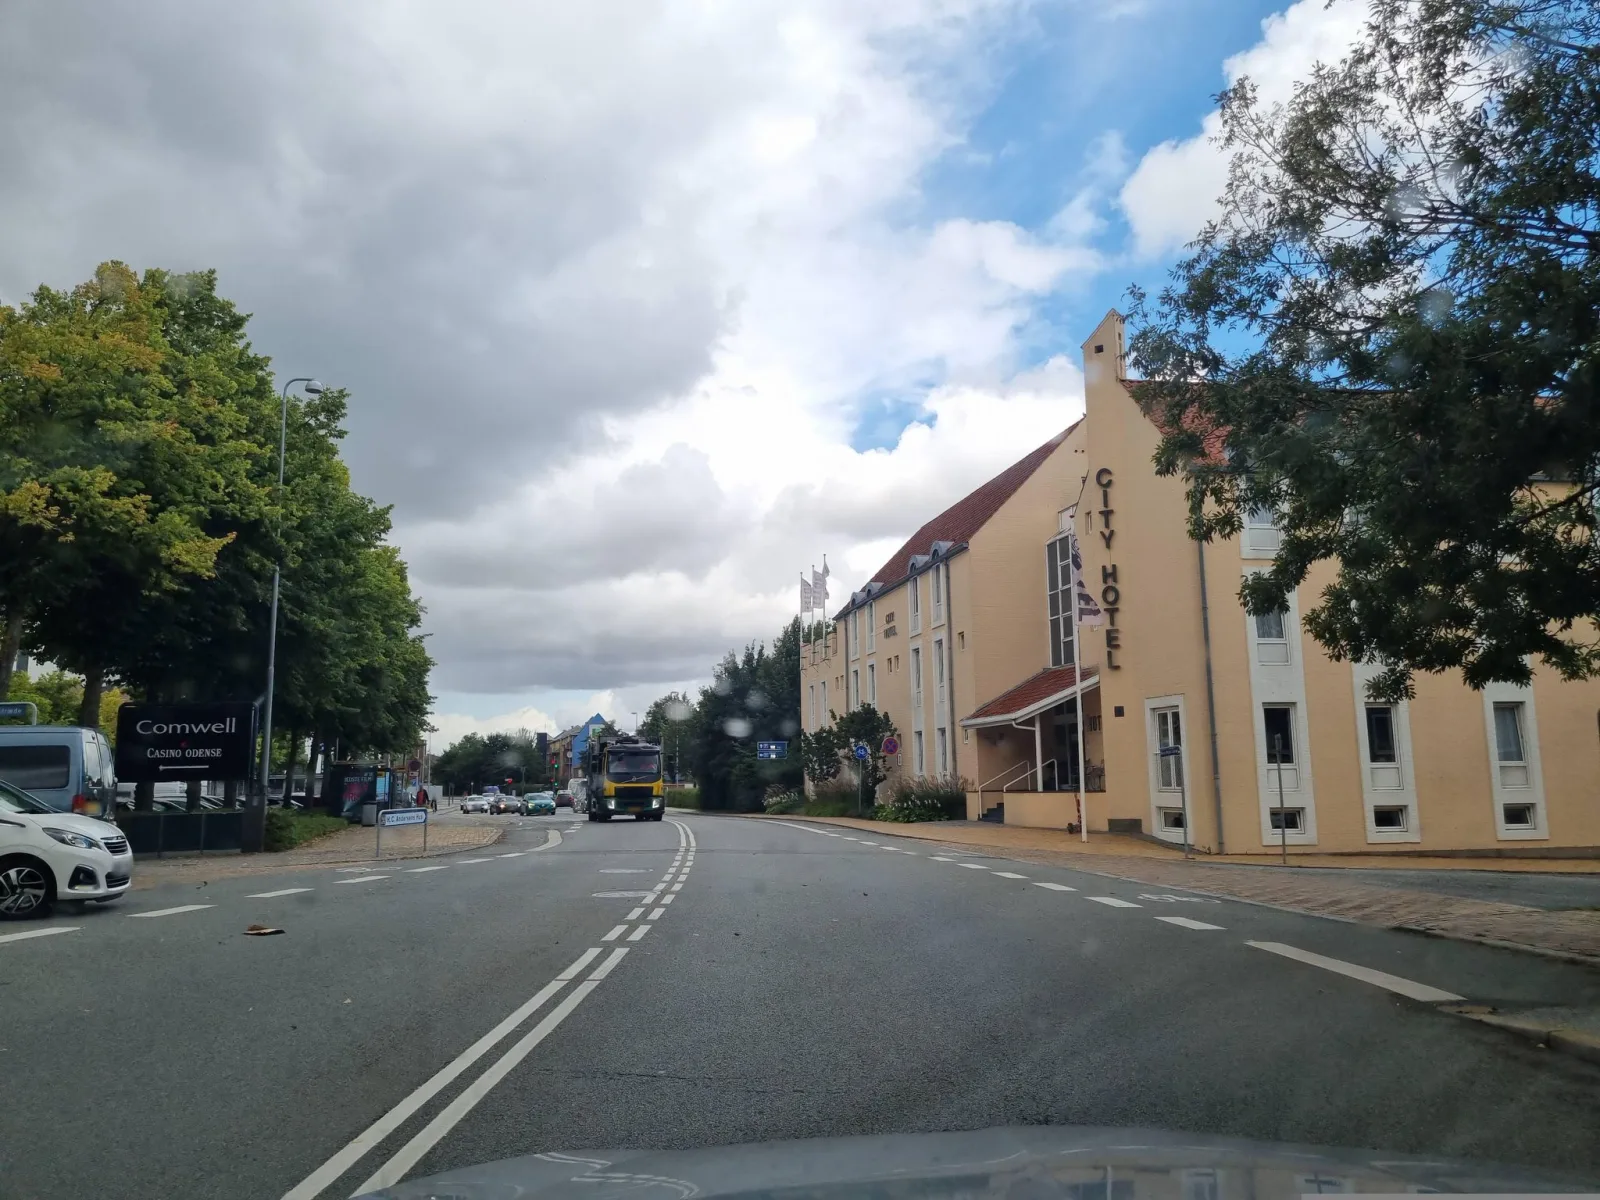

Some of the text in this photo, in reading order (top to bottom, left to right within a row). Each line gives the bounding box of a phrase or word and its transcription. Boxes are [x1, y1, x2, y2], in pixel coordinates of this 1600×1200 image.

[1096, 467, 1121, 670] CITY HOTEL
[136, 717, 236, 734] Comwell
[186, 748, 222, 758] ODENSE
